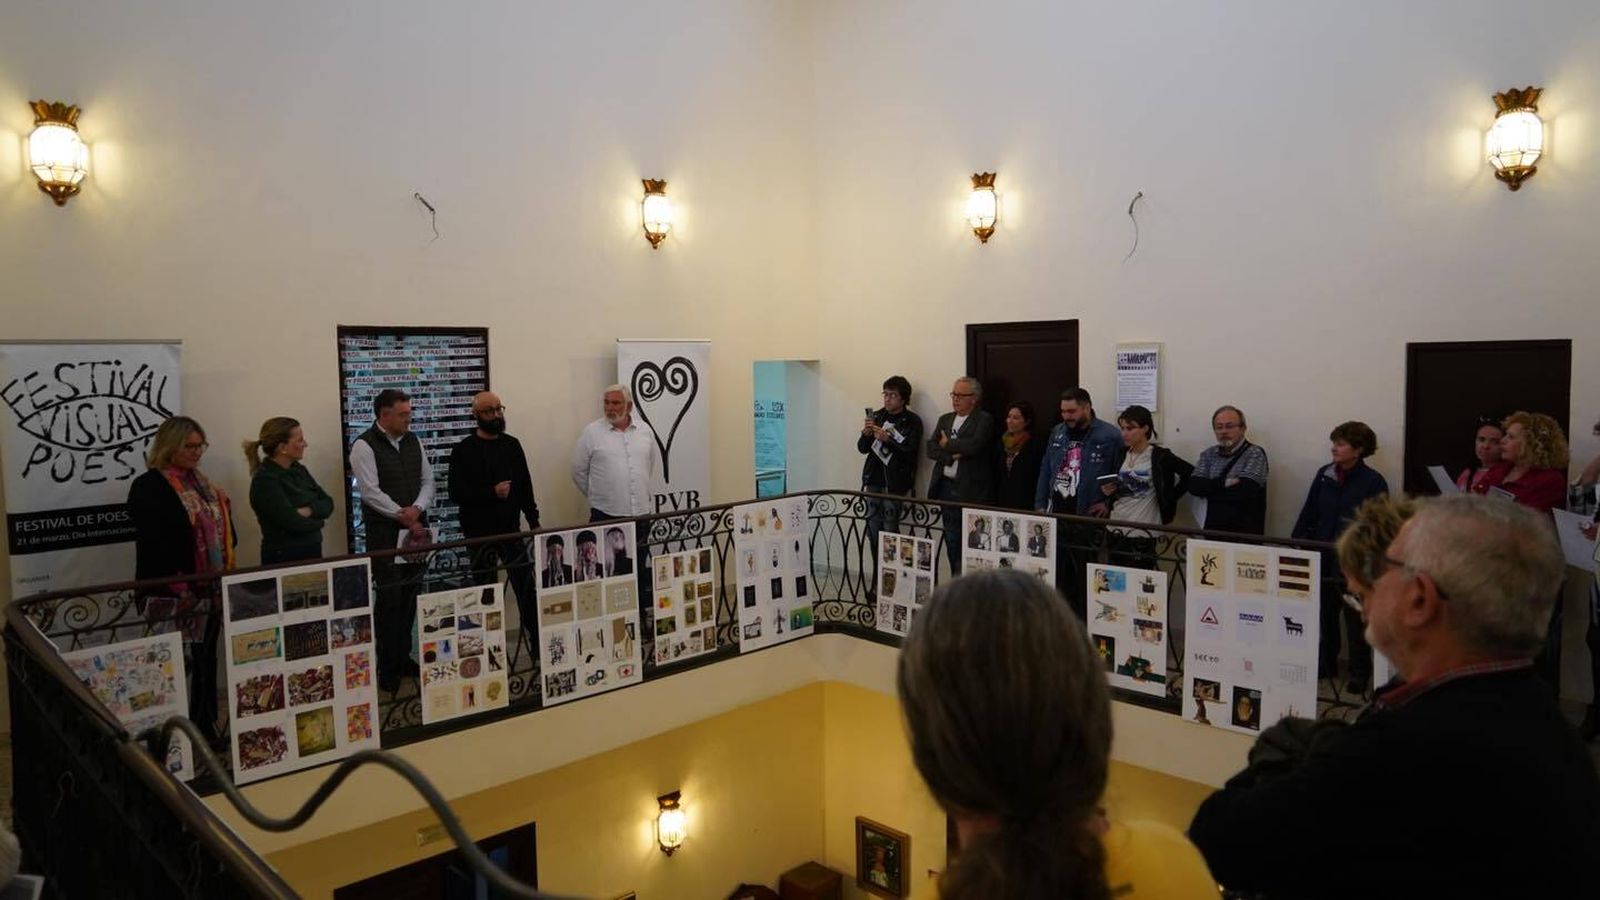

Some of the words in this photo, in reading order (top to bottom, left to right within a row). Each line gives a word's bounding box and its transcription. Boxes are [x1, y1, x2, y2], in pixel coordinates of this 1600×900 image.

[654, 490, 700, 513] PVB
[15, 517, 74, 532] FESTIVAL
[77, 513, 94, 526] DE
[97, 511, 130, 524] POES
[17, 536, 27, 546] 21
[29, 534, 41, 544] de
